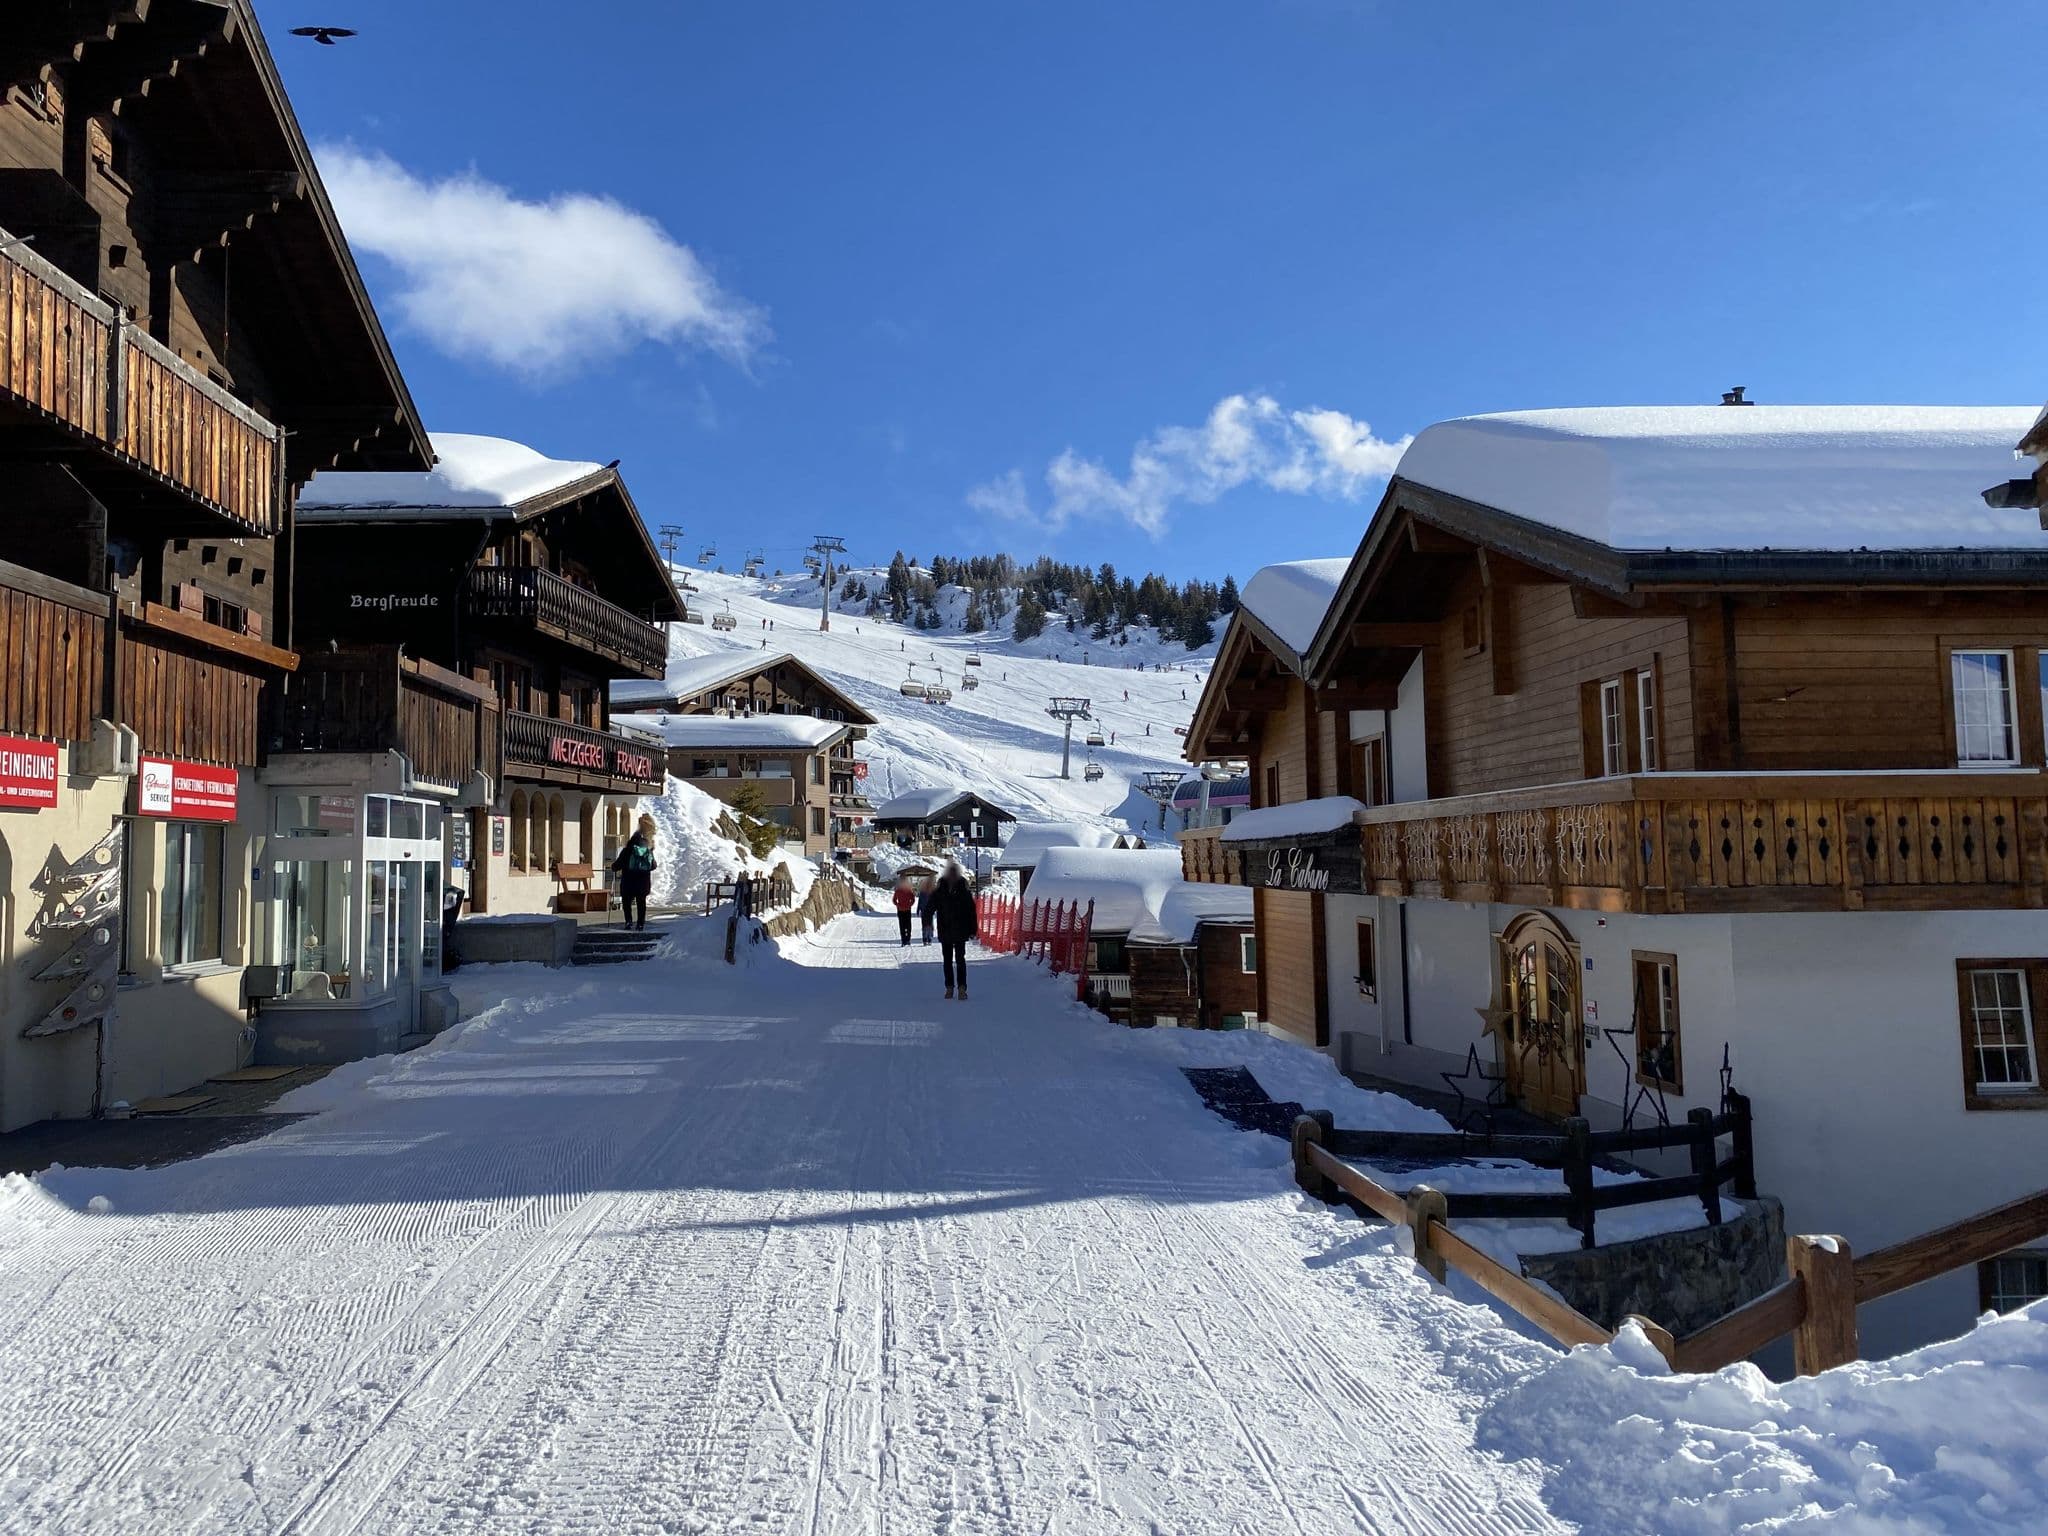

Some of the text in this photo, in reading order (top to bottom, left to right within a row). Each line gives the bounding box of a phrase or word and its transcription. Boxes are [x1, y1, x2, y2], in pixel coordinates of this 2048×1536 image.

[350, 594, 439, 611] Bergfreude
[551, 737, 652, 778] METZGEREI FRANZEN
[150, 793, 169, 803] SERVICE
[1265, 847, 1329, 890] La Cabane
